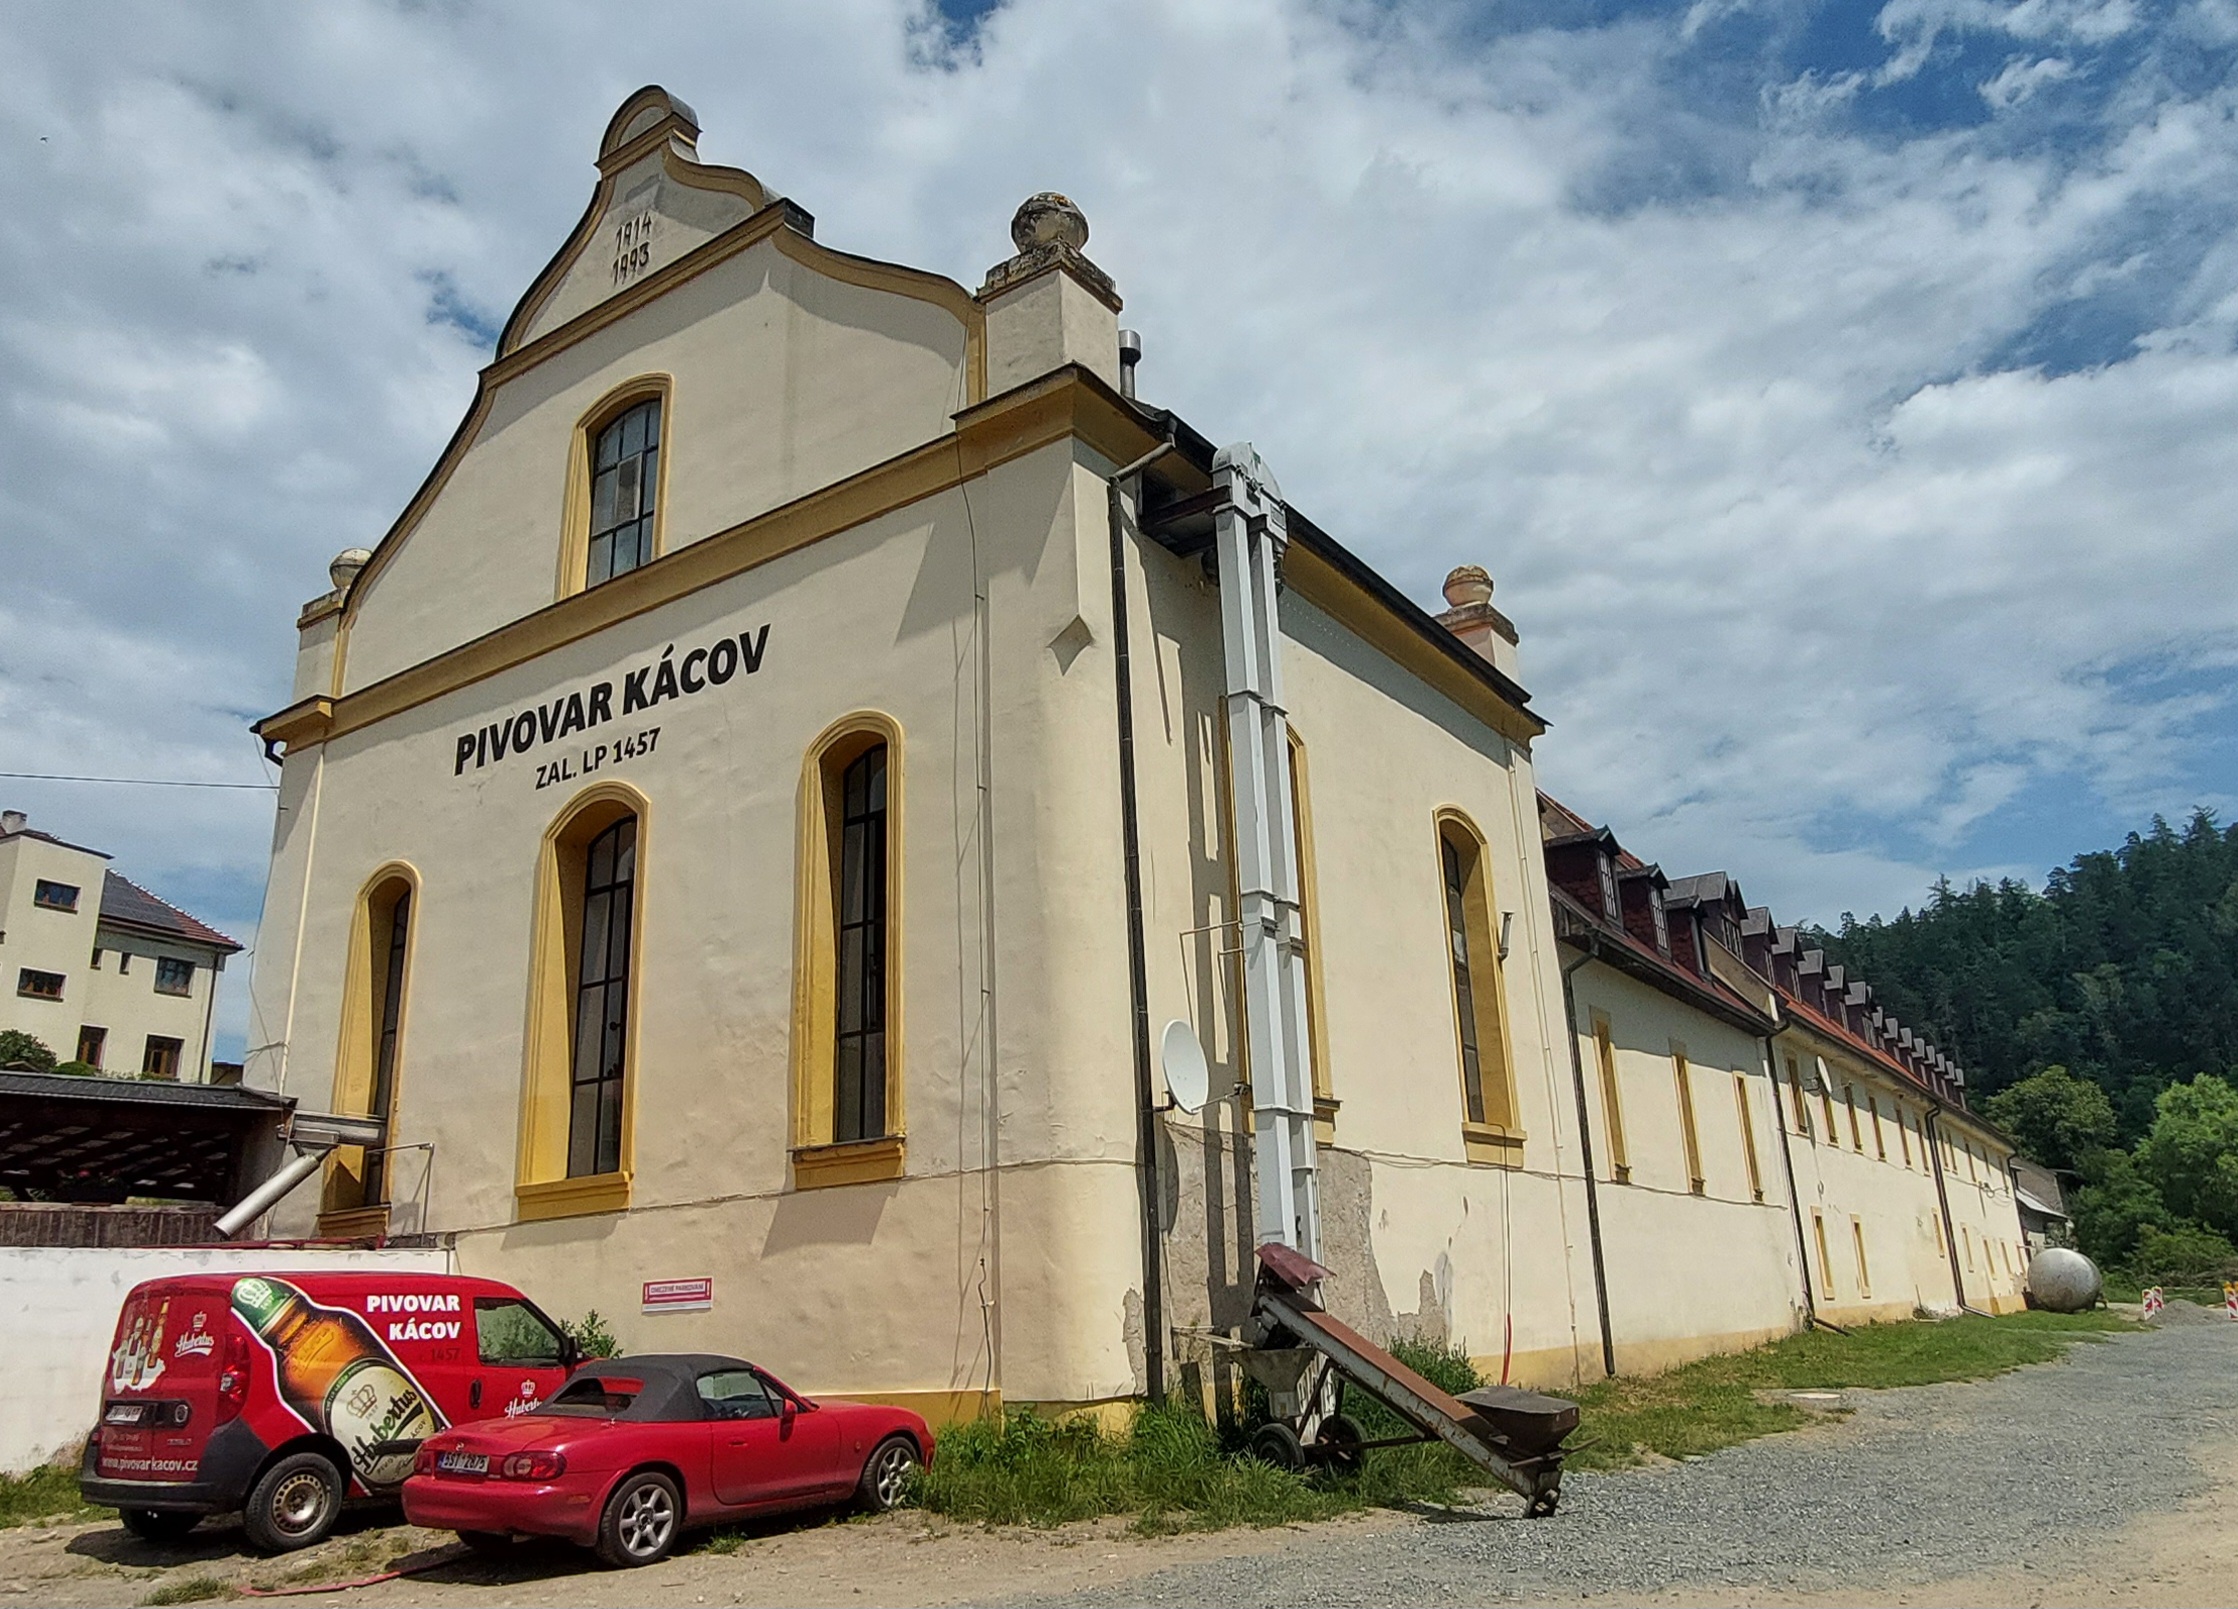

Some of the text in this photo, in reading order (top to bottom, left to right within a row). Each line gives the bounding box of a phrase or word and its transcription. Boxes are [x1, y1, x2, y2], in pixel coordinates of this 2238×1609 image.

[615, 211, 652, 254] 1914
[612, 241, 650, 287] 1993
[454, 623, 771, 776] PIVOVAR KÁCOV
[536, 727, 661, 790] ZAL. LP 1457
[366, 1294, 460, 1313] PIVOVAR
[389, 1317, 461, 1341] KÁCOV
[432, 1347, 461, 1361] 1457
[351, 1389, 417, 1475] Hubertus
[102, 1456, 198, 1471] www.pivovarkacov.cz
